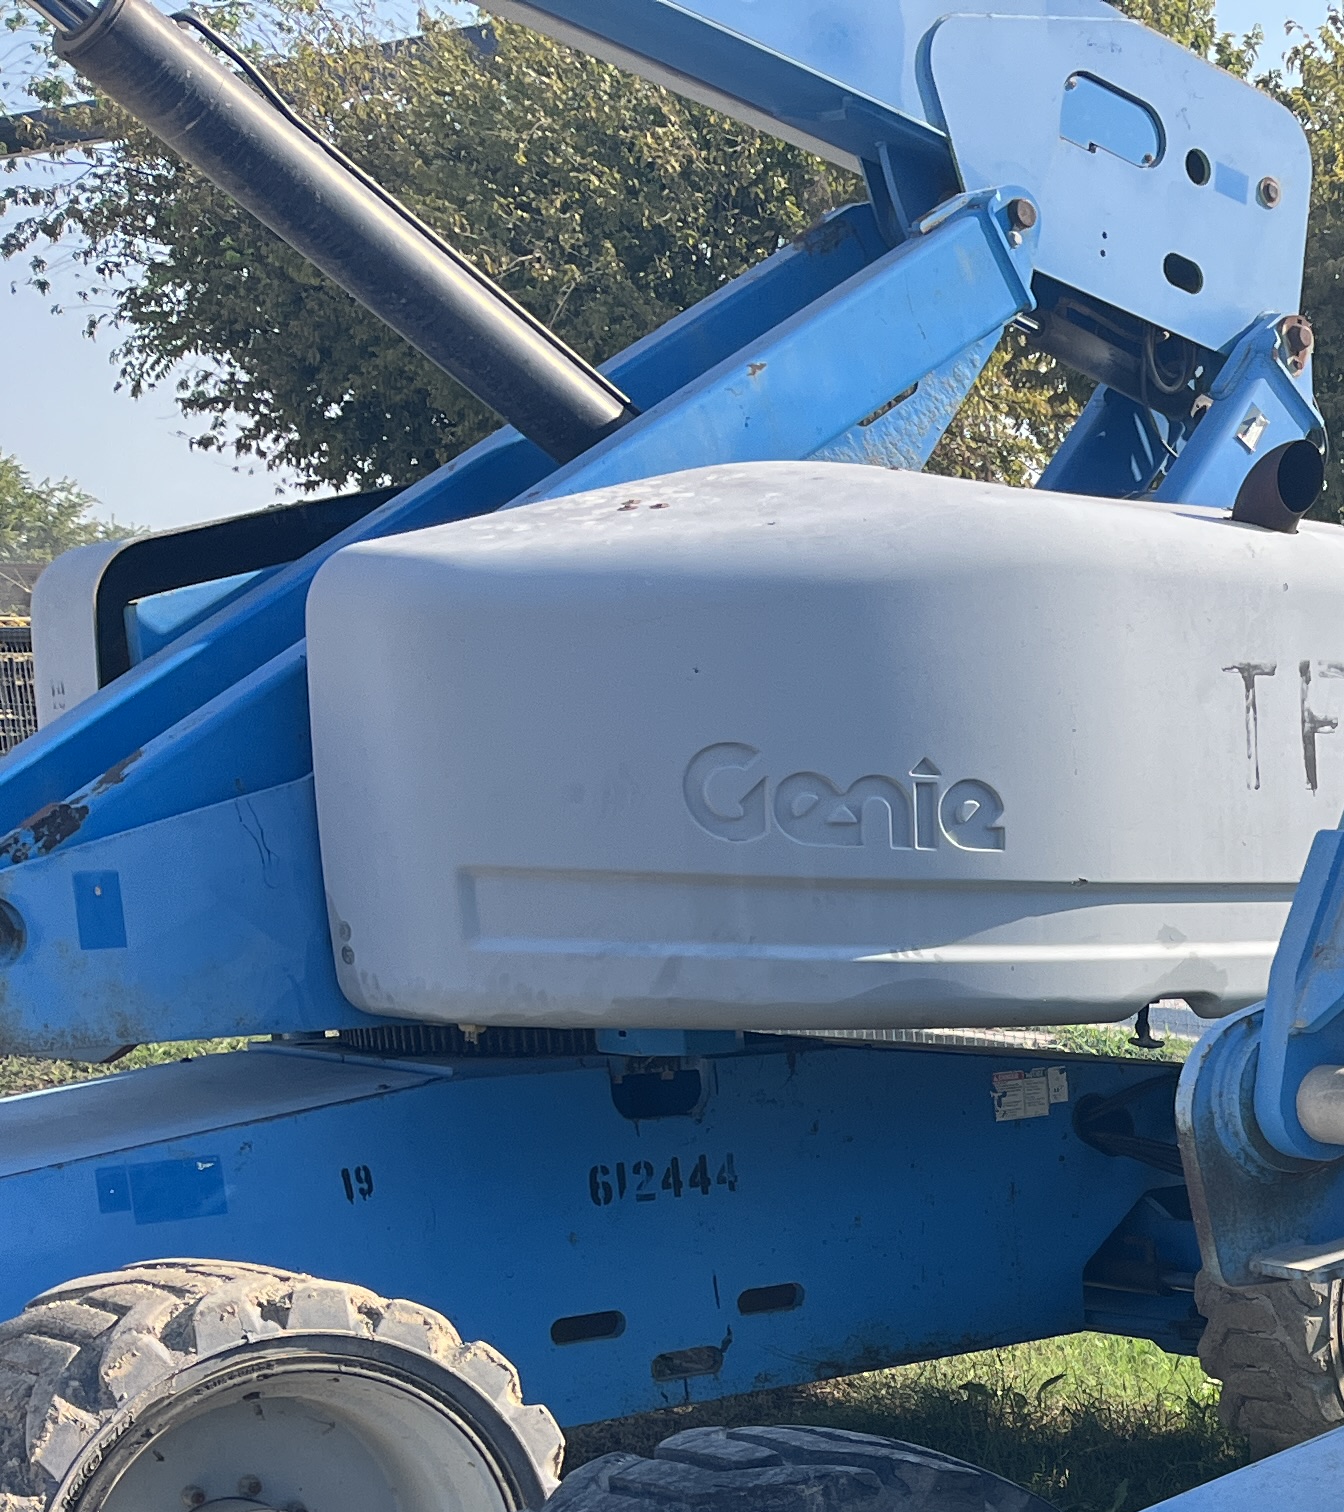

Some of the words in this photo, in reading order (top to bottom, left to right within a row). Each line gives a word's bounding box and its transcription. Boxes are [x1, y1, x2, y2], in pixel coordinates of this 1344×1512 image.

[682, 741, 1006, 853] Genie
[340, 1164, 375, 1205] 19
[588, 1152, 739, 1207] 612444
